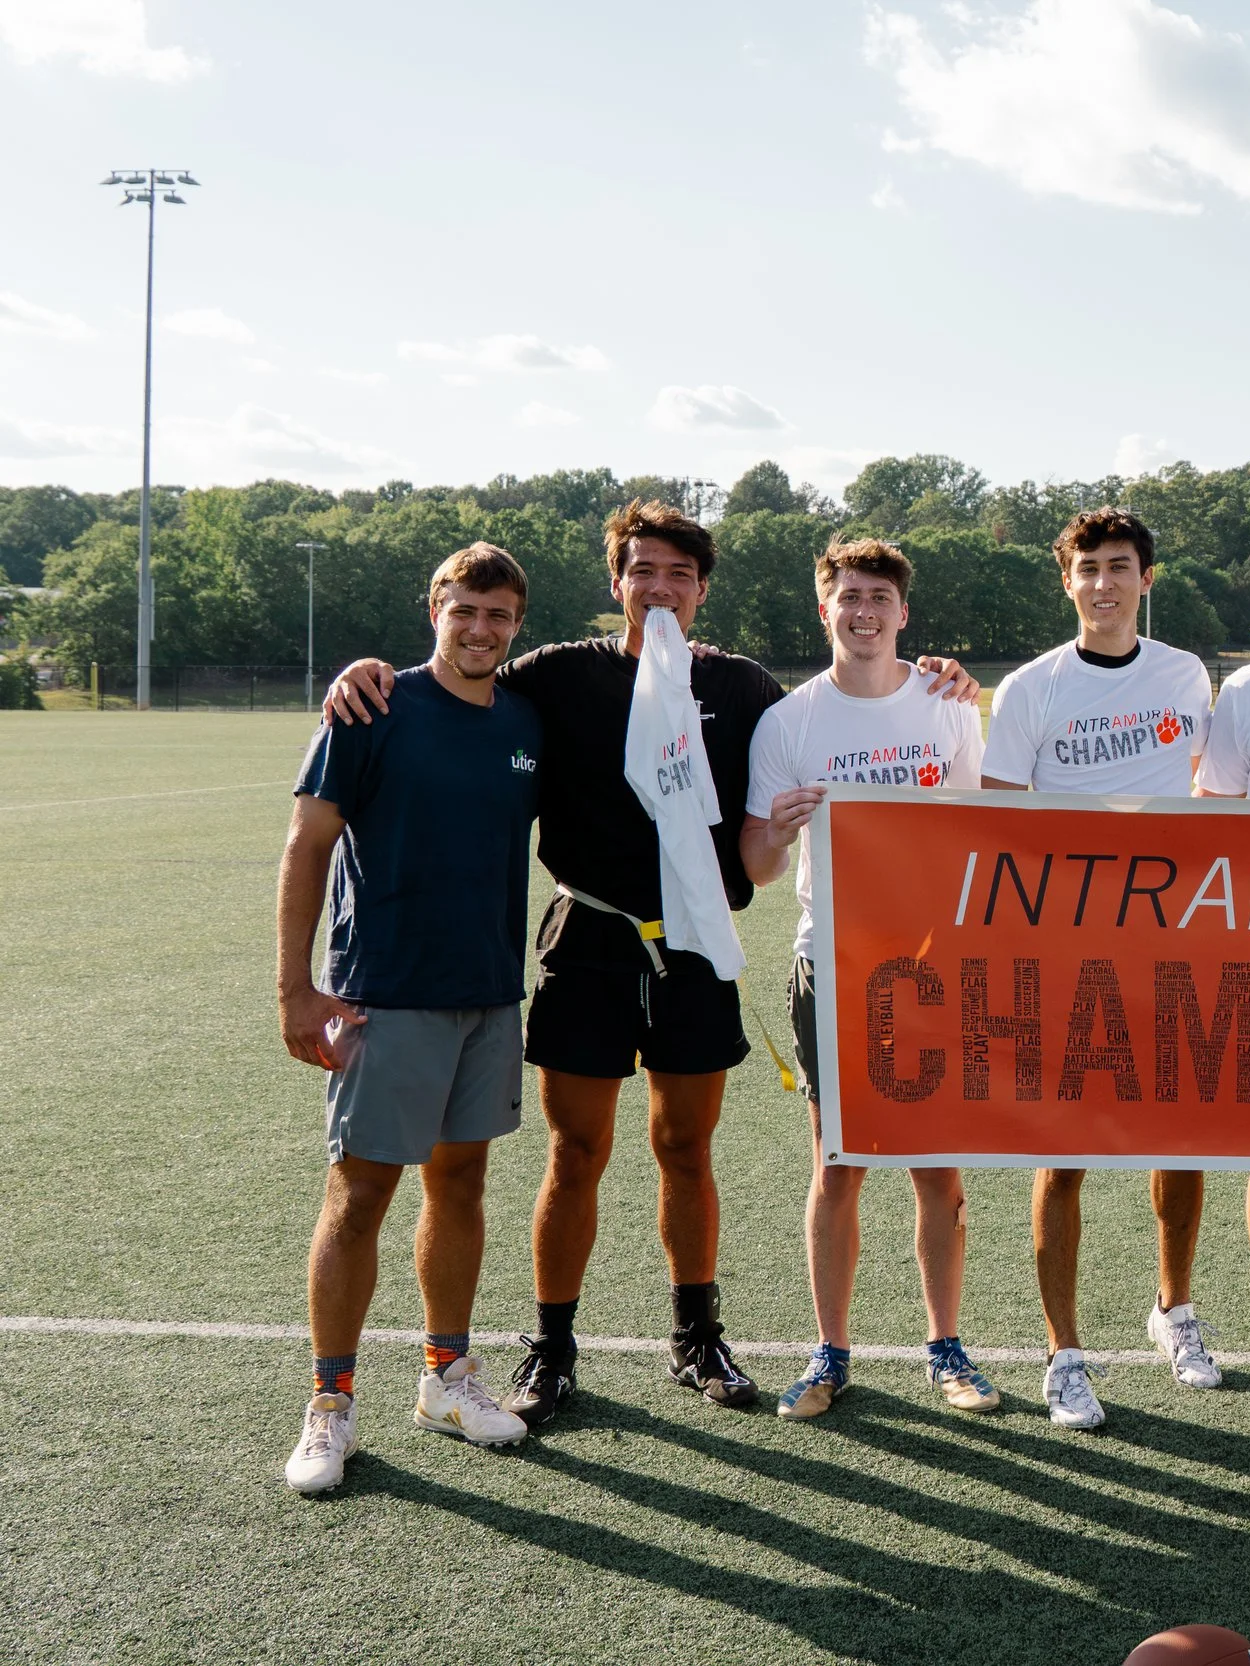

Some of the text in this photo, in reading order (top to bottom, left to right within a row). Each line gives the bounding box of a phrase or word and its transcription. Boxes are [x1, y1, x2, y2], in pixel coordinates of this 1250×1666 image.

[1068, 706, 1177, 734] INTRAMURAL
[1055, 714, 1194, 765] CHAMPIN
[827, 743, 941, 771] INTRAMURAL
[897, 961, 928, 970] EFFORT
[961, 958, 988, 966] TENNIS
[1013, 958, 1040, 967] EFFORT
[1082, 959, 1113, 967] COMPETE
[1022, 966, 1032, 985] FUN
[1080, 967, 1116, 975] KICKBALL
[961, 977, 987, 988] FLAG
[918, 984, 944, 995] FLAG
[1014, 966, 1022, 1016] DETERMINATION
[1033, 965, 1041, 1017] SPORTSMANSHIP
[1023, 985, 1032, 1017] SOCCER
[1179, 993, 1197, 1003] FUN
[970, 998, 980, 1015] FUN
[1073, 1002, 1096, 1012] PLAY
[970, 1016, 1013, 1025] SPIKEBALL
[1155, 1014, 1178, 1025] PLAY
[1213, 1012, 1233, 1021] PLAY
[880, 990, 895, 1063] VOLLEYBALL
[1185, 1018, 1203, 1027] FLAG
[981, 1025, 1014, 1033] FOOTBALL
[1107, 1030, 1129, 1040] FUN
[1015, 1035, 1041, 1046] FLAG
[1067, 1037, 1090, 1047] FLAG
[963, 1034, 973, 1072] RESPECT
[973, 1033, 988, 1063] PLAY
[1096, 1046, 1133, 1054] TEAMWORK
[1064, 1054, 1115, 1064] BATTLESHIP
[1116, 1055, 1134, 1064] FUN
[974, 1064, 989, 1072] FUN
[1063, 1063, 1115, 1071] DETERMINATION
[1114, 1064, 1136, 1073] PLAY
[1162, 1047, 1172, 1088] SPIKEBALL
[1016, 1068, 1035, 1078] FUN
[1016, 1078, 1034, 1086] PLAY
[1057, 1090, 1083, 1101] PLAY
[1155, 1088, 1178, 1097] FLAG
[1117, 1094, 1143, 1102] TENNIS
[1200, 1095, 1215, 1103] FUN
